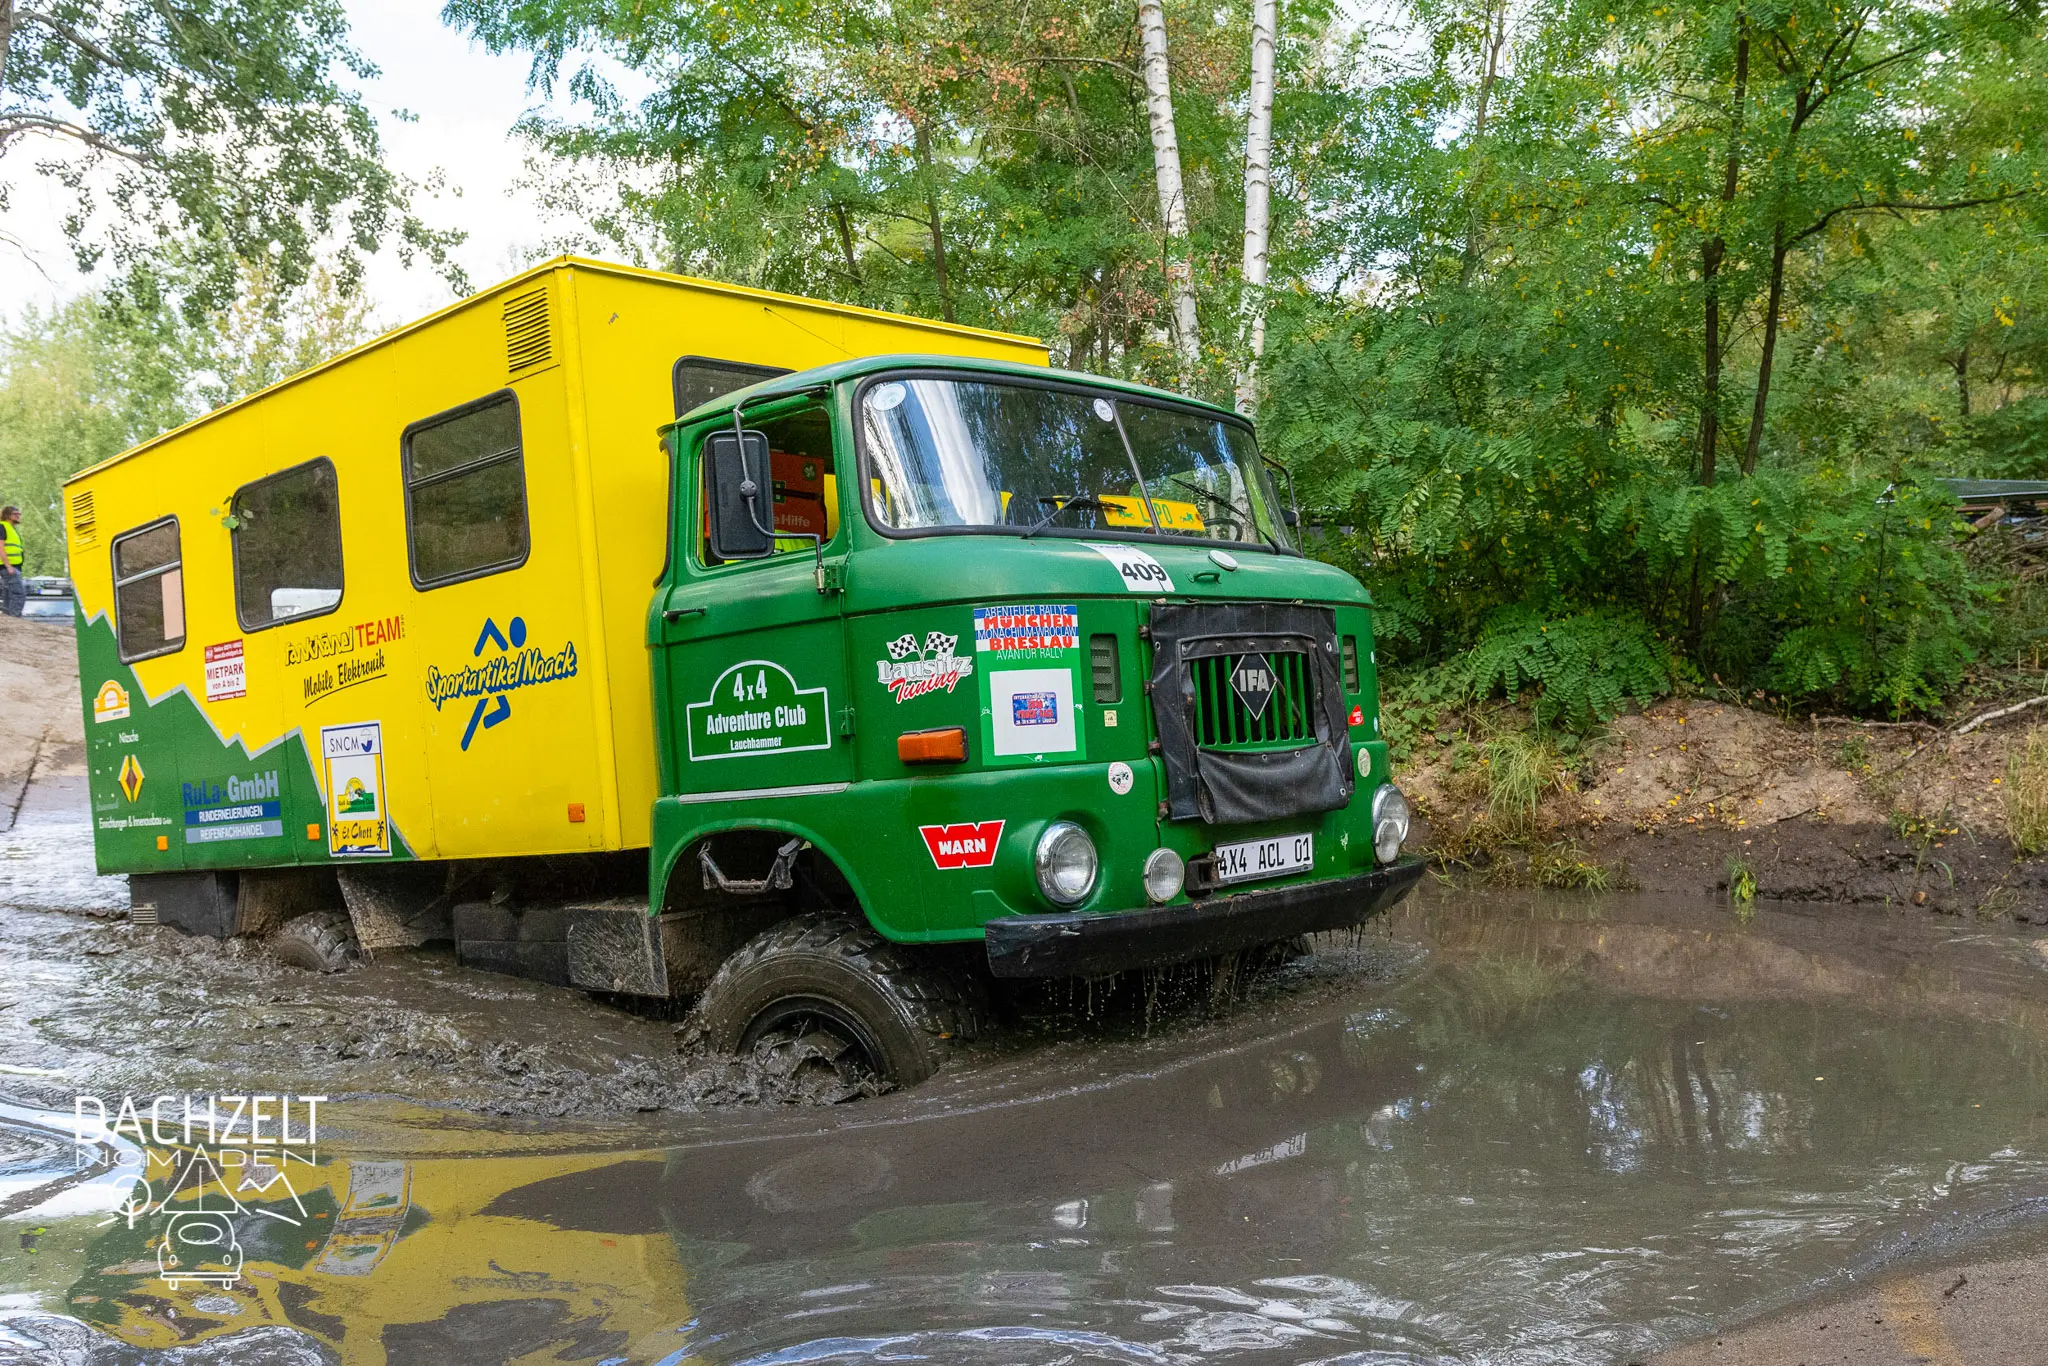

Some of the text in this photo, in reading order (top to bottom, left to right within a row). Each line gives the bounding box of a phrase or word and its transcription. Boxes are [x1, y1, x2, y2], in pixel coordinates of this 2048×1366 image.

[781, 514, 810, 527] Hilfe
[1121, 562, 1167, 581] 409
[984, 604, 1068, 618] ABENTEUER RALLYE
[983, 614, 1073, 630] MÜNCHEN
[355, 616, 401, 648] TEAM
[989, 636, 1073, 651] BRESLAU
[996, 647, 1064, 660] AVANTUR RALLY
[206, 662, 244, 680] MIETPARK
[303, 648, 386, 699] Mobile Elektronik
[425, 641, 578, 712] Sportartikel Noack
[876, 652, 974, 684] Lausitz
[212, 682, 221, 690] von
[227, 679, 235, 687] bis
[888, 669, 961, 704] Tuning
[1239, 669, 1270, 692] IFA
[706, 704, 807, 735] Adventure Club
[330, 736, 359, 752] SNCM
[730, 736, 782, 751] Lauchhammer
[227, 770, 280, 802] GmbH
[199, 804, 263, 822] RUNDERNEUERUNGEN
[200, 823, 265, 839] REIFENFACHHANDEL
[351, 822, 373, 840] Chott
[938, 837, 987, 855] WARN
[1219, 847, 1247, 876] 4X4
[1258, 842, 1285, 874] ACL
[1294, 837, 1311, 863] 01
